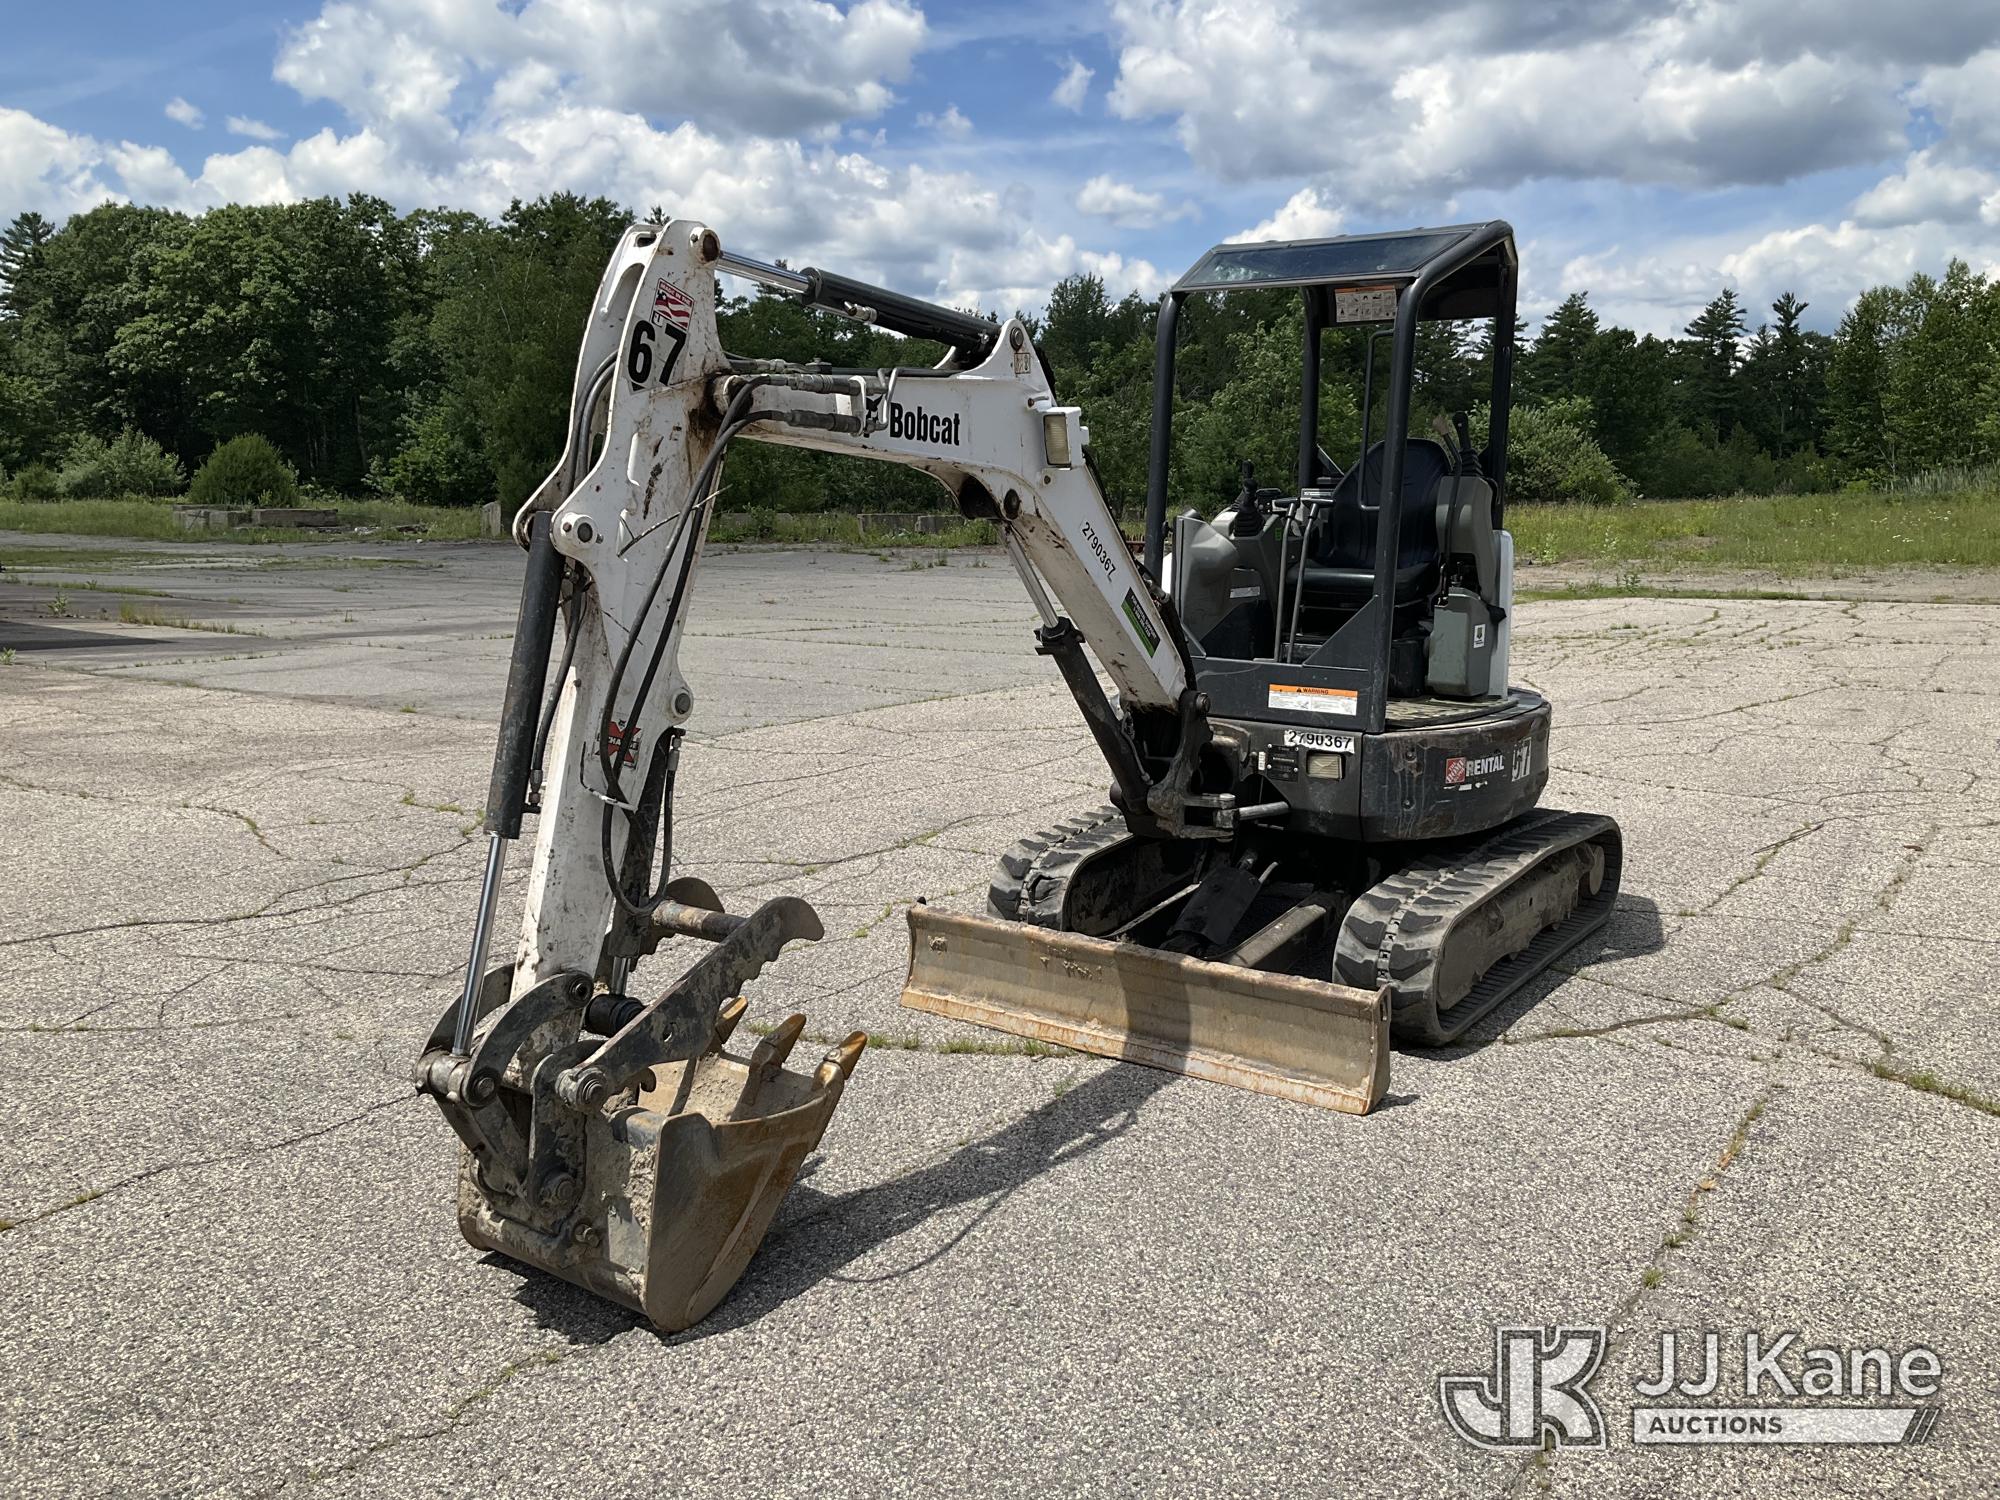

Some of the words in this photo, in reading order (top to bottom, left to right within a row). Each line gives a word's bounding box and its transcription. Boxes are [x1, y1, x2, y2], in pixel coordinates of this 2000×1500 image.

[628, 320, 687, 386] 67
[889, 401, 960, 446] Bobcat
[1081, 521, 1116, 580] 2790367
[1302, 687, 1329, 695] WARNING
[1465, 755, 1505, 777] RENTAL
